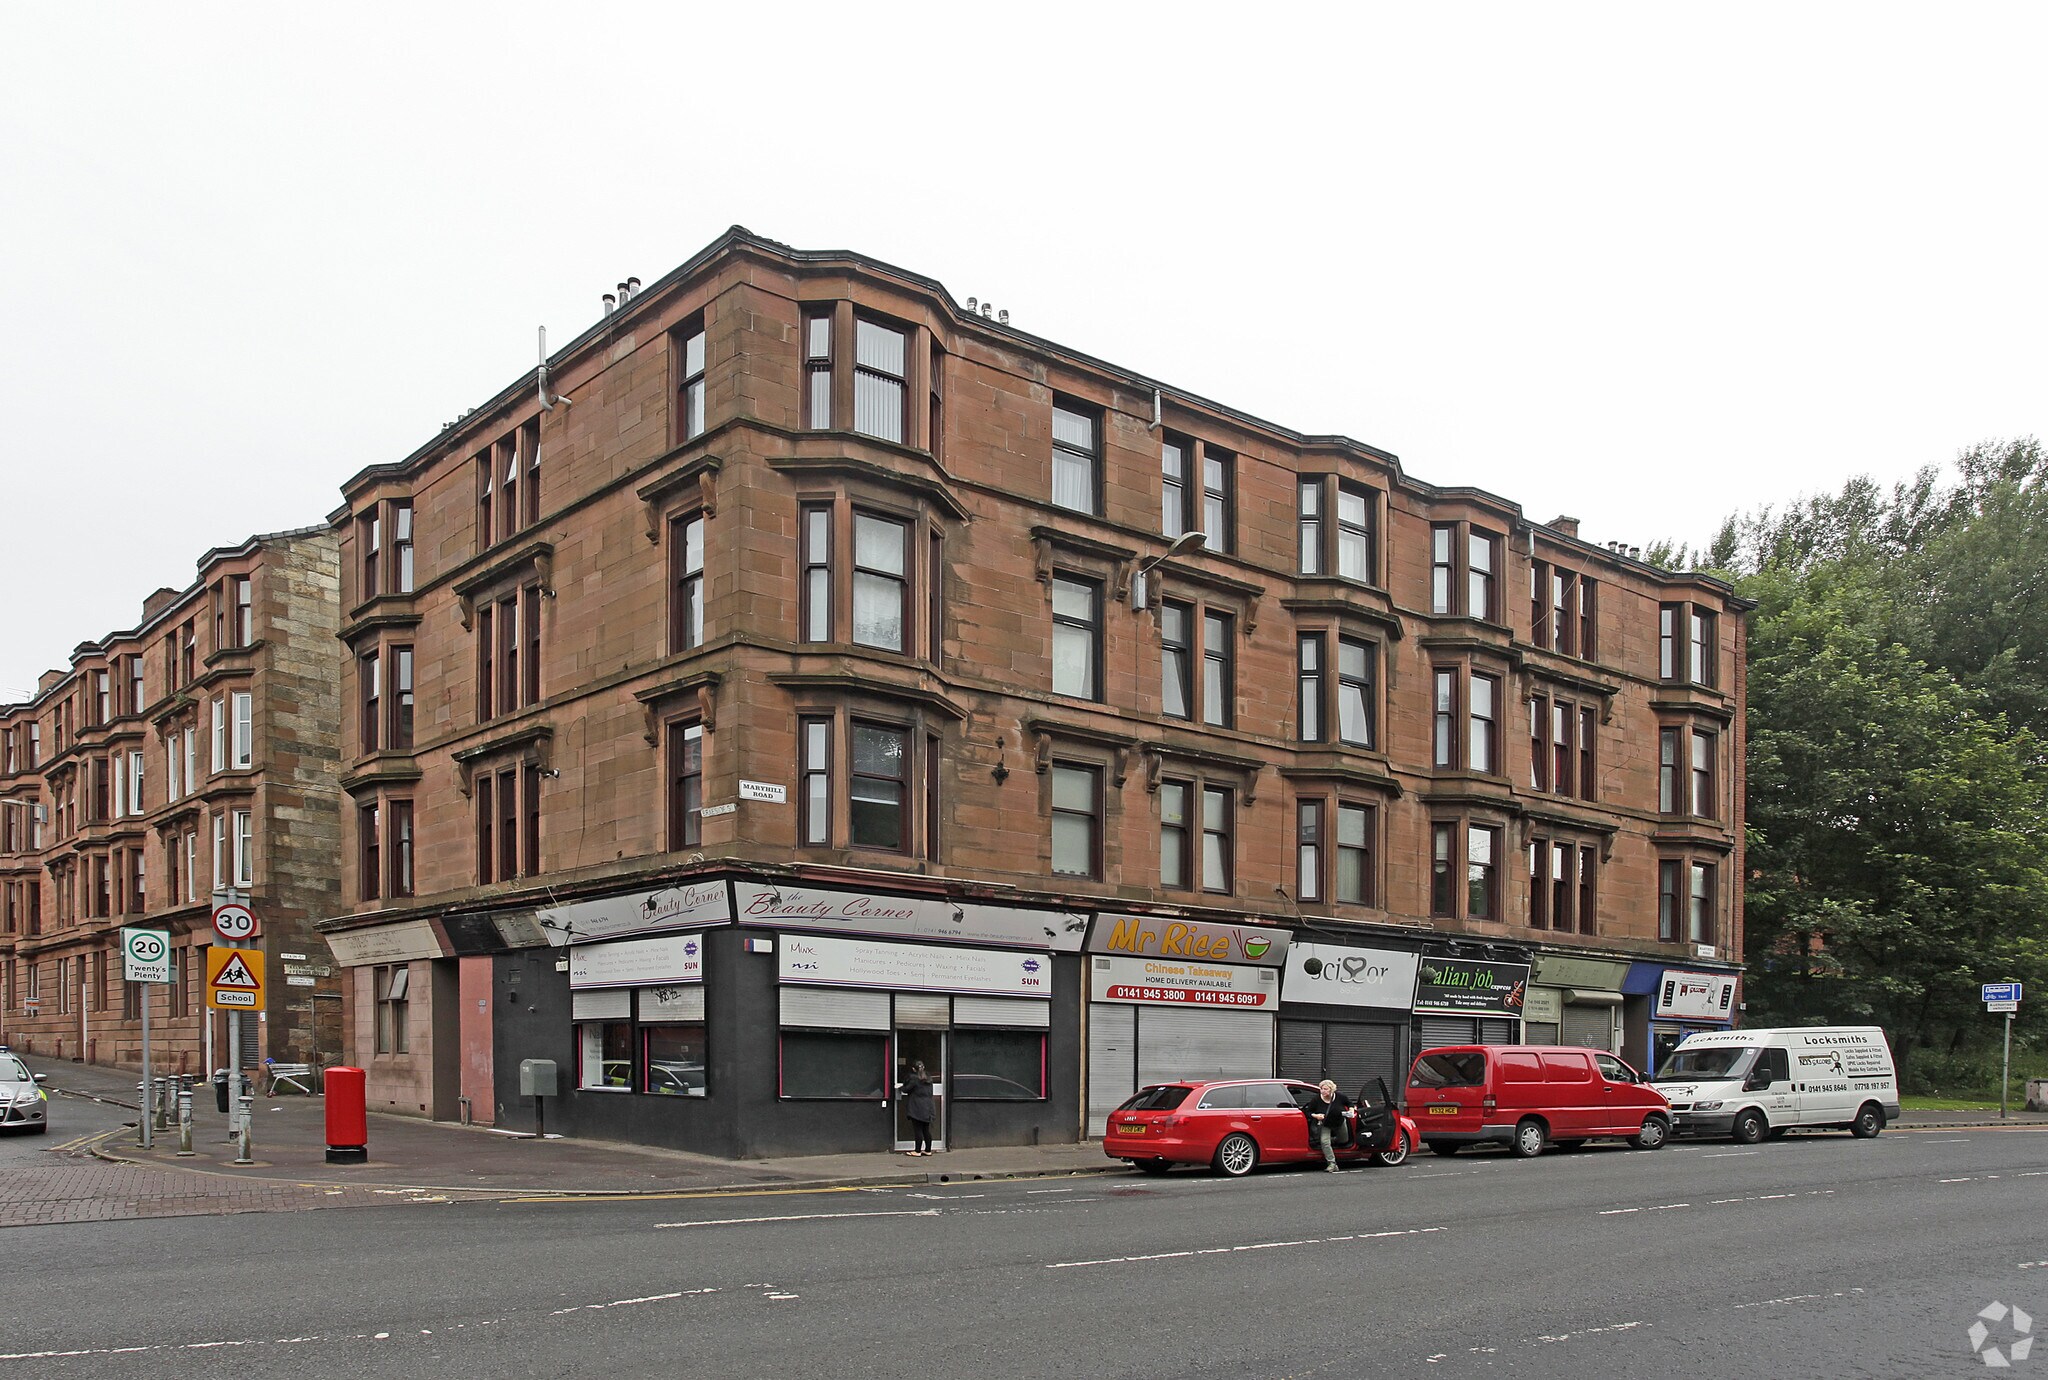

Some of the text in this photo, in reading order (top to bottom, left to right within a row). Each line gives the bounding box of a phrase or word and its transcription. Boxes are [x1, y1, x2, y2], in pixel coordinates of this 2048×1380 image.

[743, 784, 783, 794] MARYHILL
[685, 887, 724, 906] Corner
[787, 892, 803, 901] the
[744, 893, 914, 922] Beauty Corner
[218, 914, 250, 930] 30
[1107, 918, 1230, 960] Mr Rice
[134, 941, 160, 954] 20
[129, 964, 166, 973] Twenty's
[1145, 962, 1233, 980] Chinese Takeaway
[134, 972, 161, 980] Plenty
[1145, 976, 1232, 988] HOME DELIVERY AVAILABLE
[1433, 966, 1469, 986] alian
[1469, 968, 1494, 991] job
[220, 994, 252, 1002] School
[1117, 987, 1257, 1004] 0141 945 3800 0141 945 6091
[1687, 1035, 1755, 1044] Locksmiths
[1804, 1035, 1868, 1045] Locksmiths
[1854, 1082, 1869, 1090] 07718
